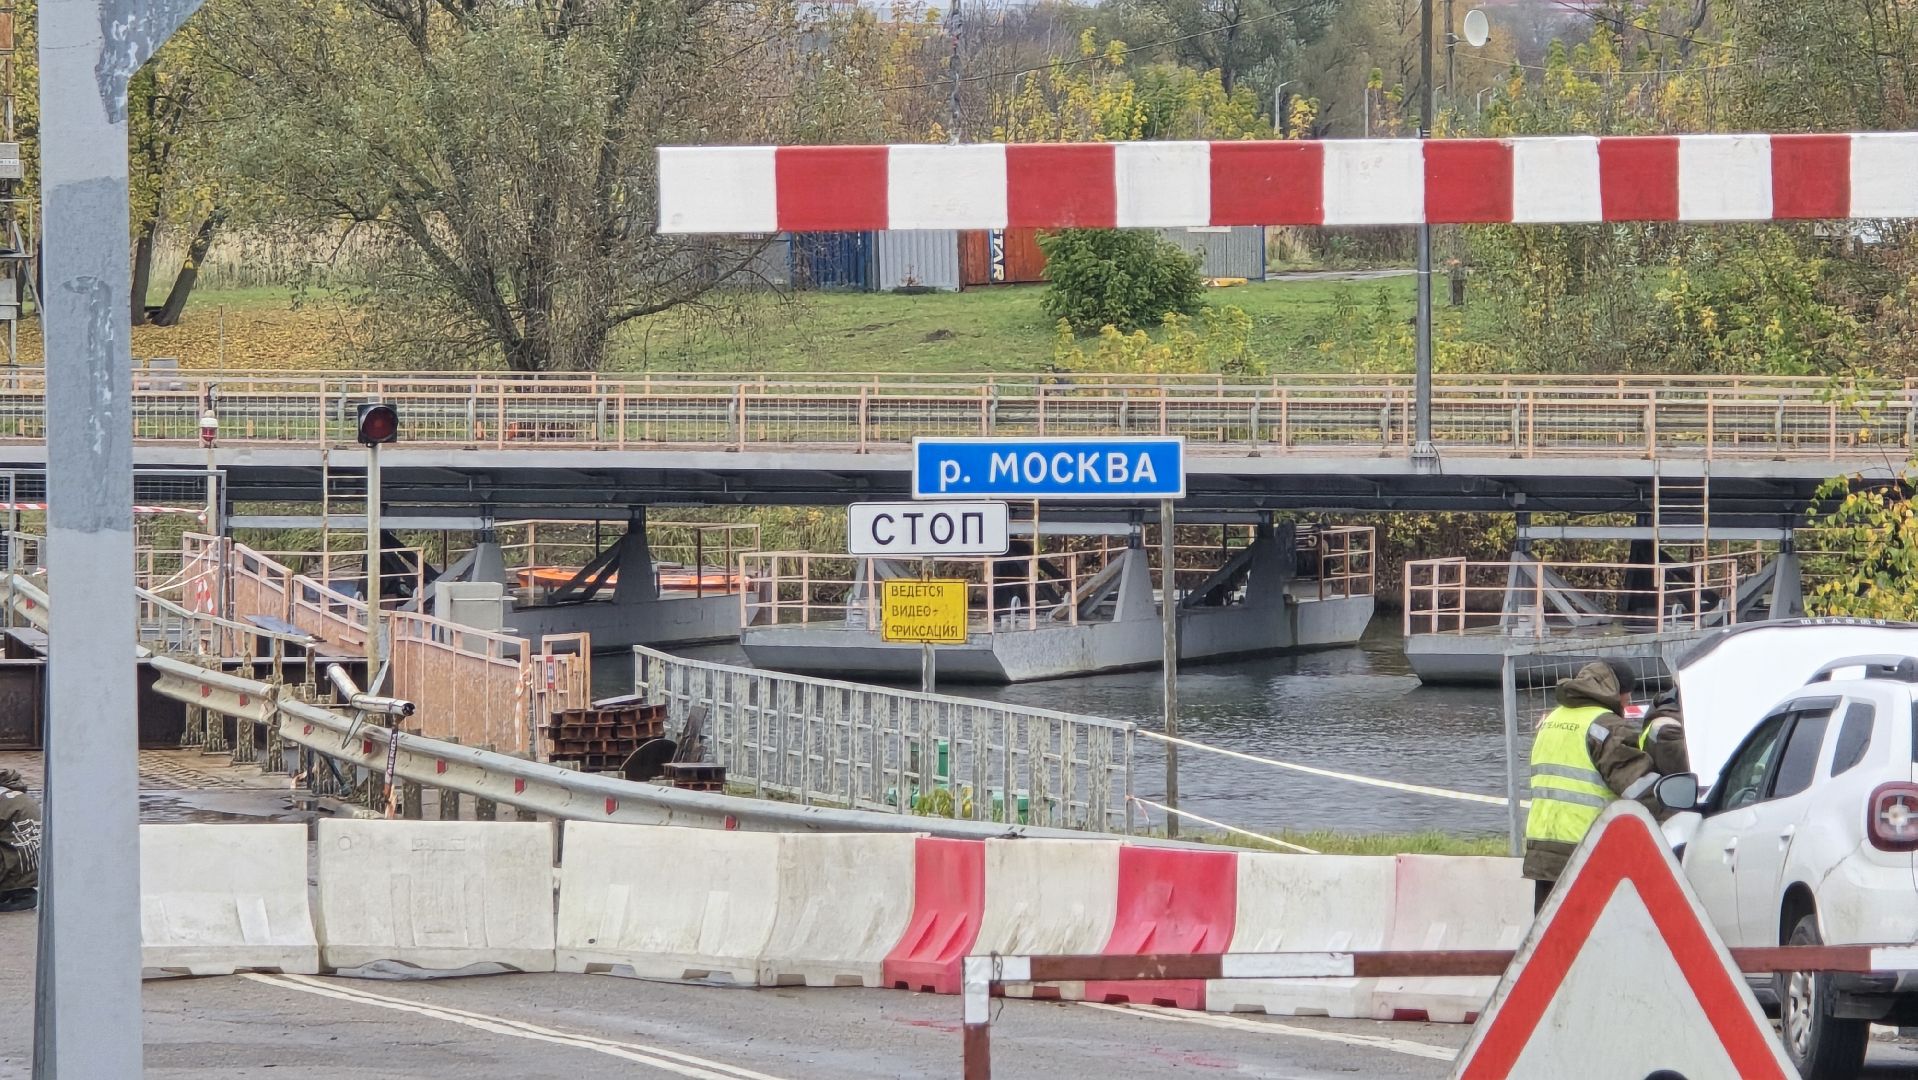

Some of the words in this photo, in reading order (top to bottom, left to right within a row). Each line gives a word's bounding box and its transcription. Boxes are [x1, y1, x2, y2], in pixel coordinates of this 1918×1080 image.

[940, 459, 971, 492] р.
[988, 452, 1158, 484] МОСКВА
[871, 512, 984, 545] СТОП
[891, 585, 944, 598] ВЕДЕТСЯ
[892, 605, 939, 618] ВИДЕО-
[891, 625, 958, 638] ФИКСАЦИЯ
